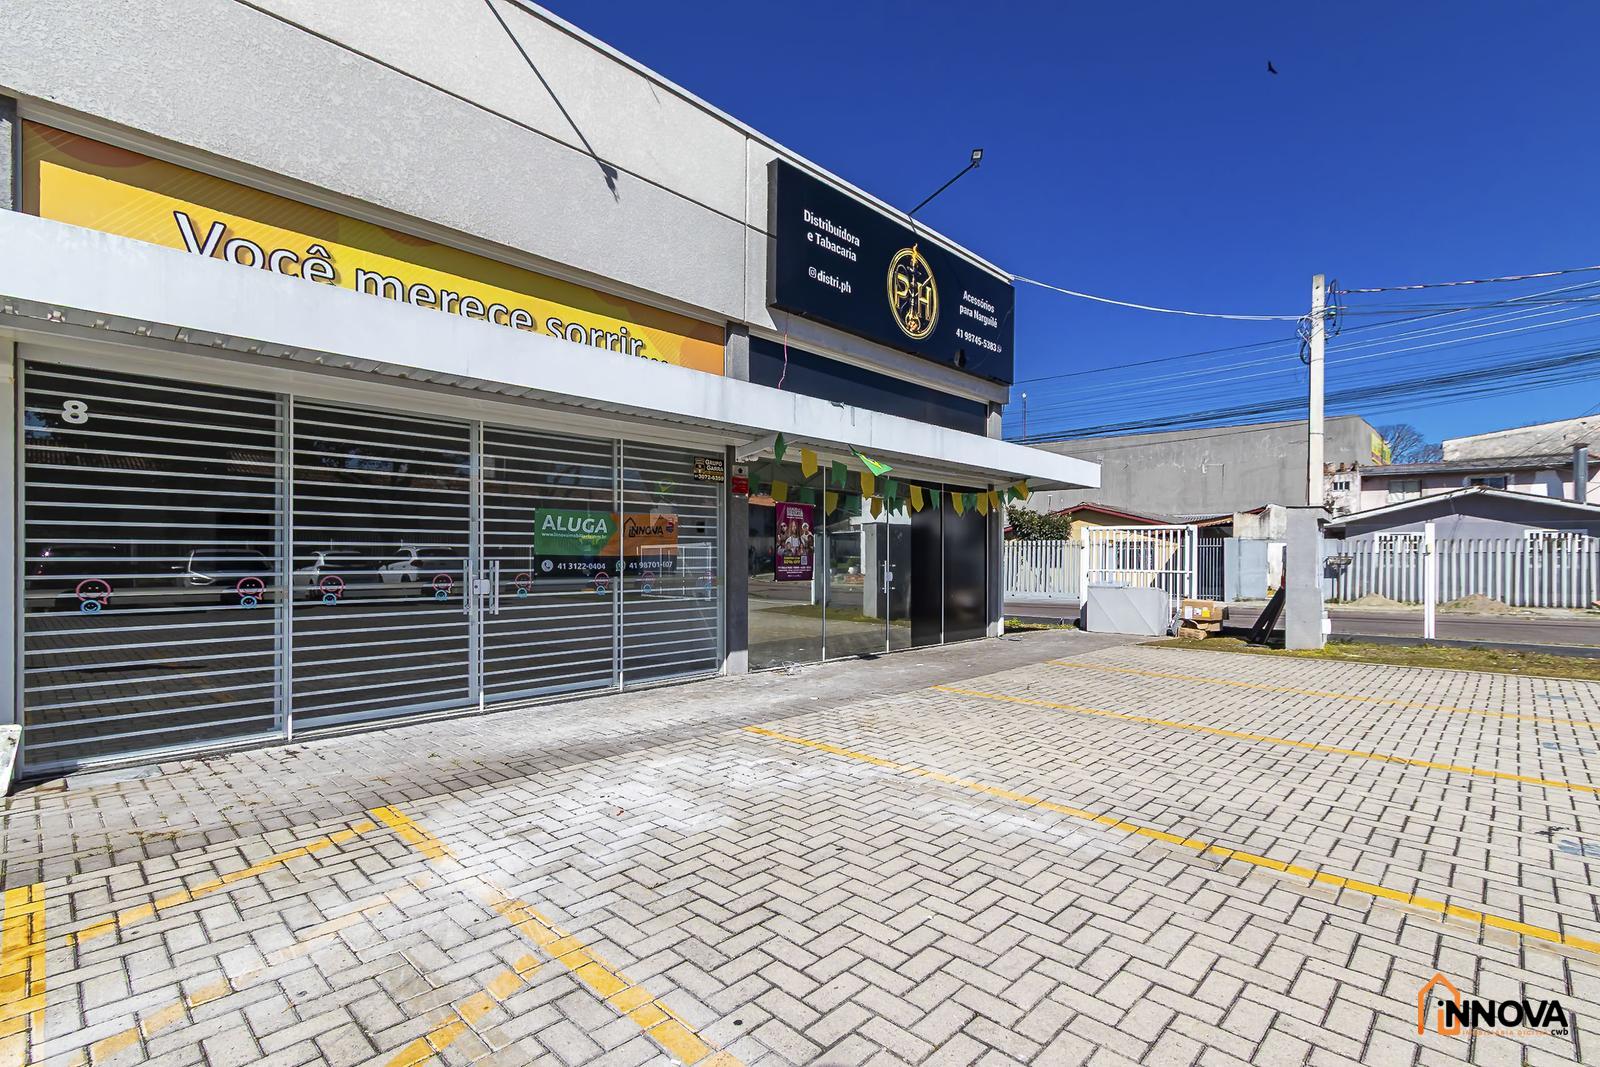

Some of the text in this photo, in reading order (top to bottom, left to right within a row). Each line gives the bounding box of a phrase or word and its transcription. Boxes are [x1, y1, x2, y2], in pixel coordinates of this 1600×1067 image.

[803, 208, 860, 247] Distribuidora
[807, 231, 857, 262] e Tabacaria
[173, 210, 336, 285] Você
[355, 267, 534, 334] merece
[959, 304, 973, 318] para
[955, 328, 964, 339] 41
[62, 400, 88, 424] 8
[541, 514, 608, 534] ALUGA
[557, 561, 606, 571] 41 3122-0404
